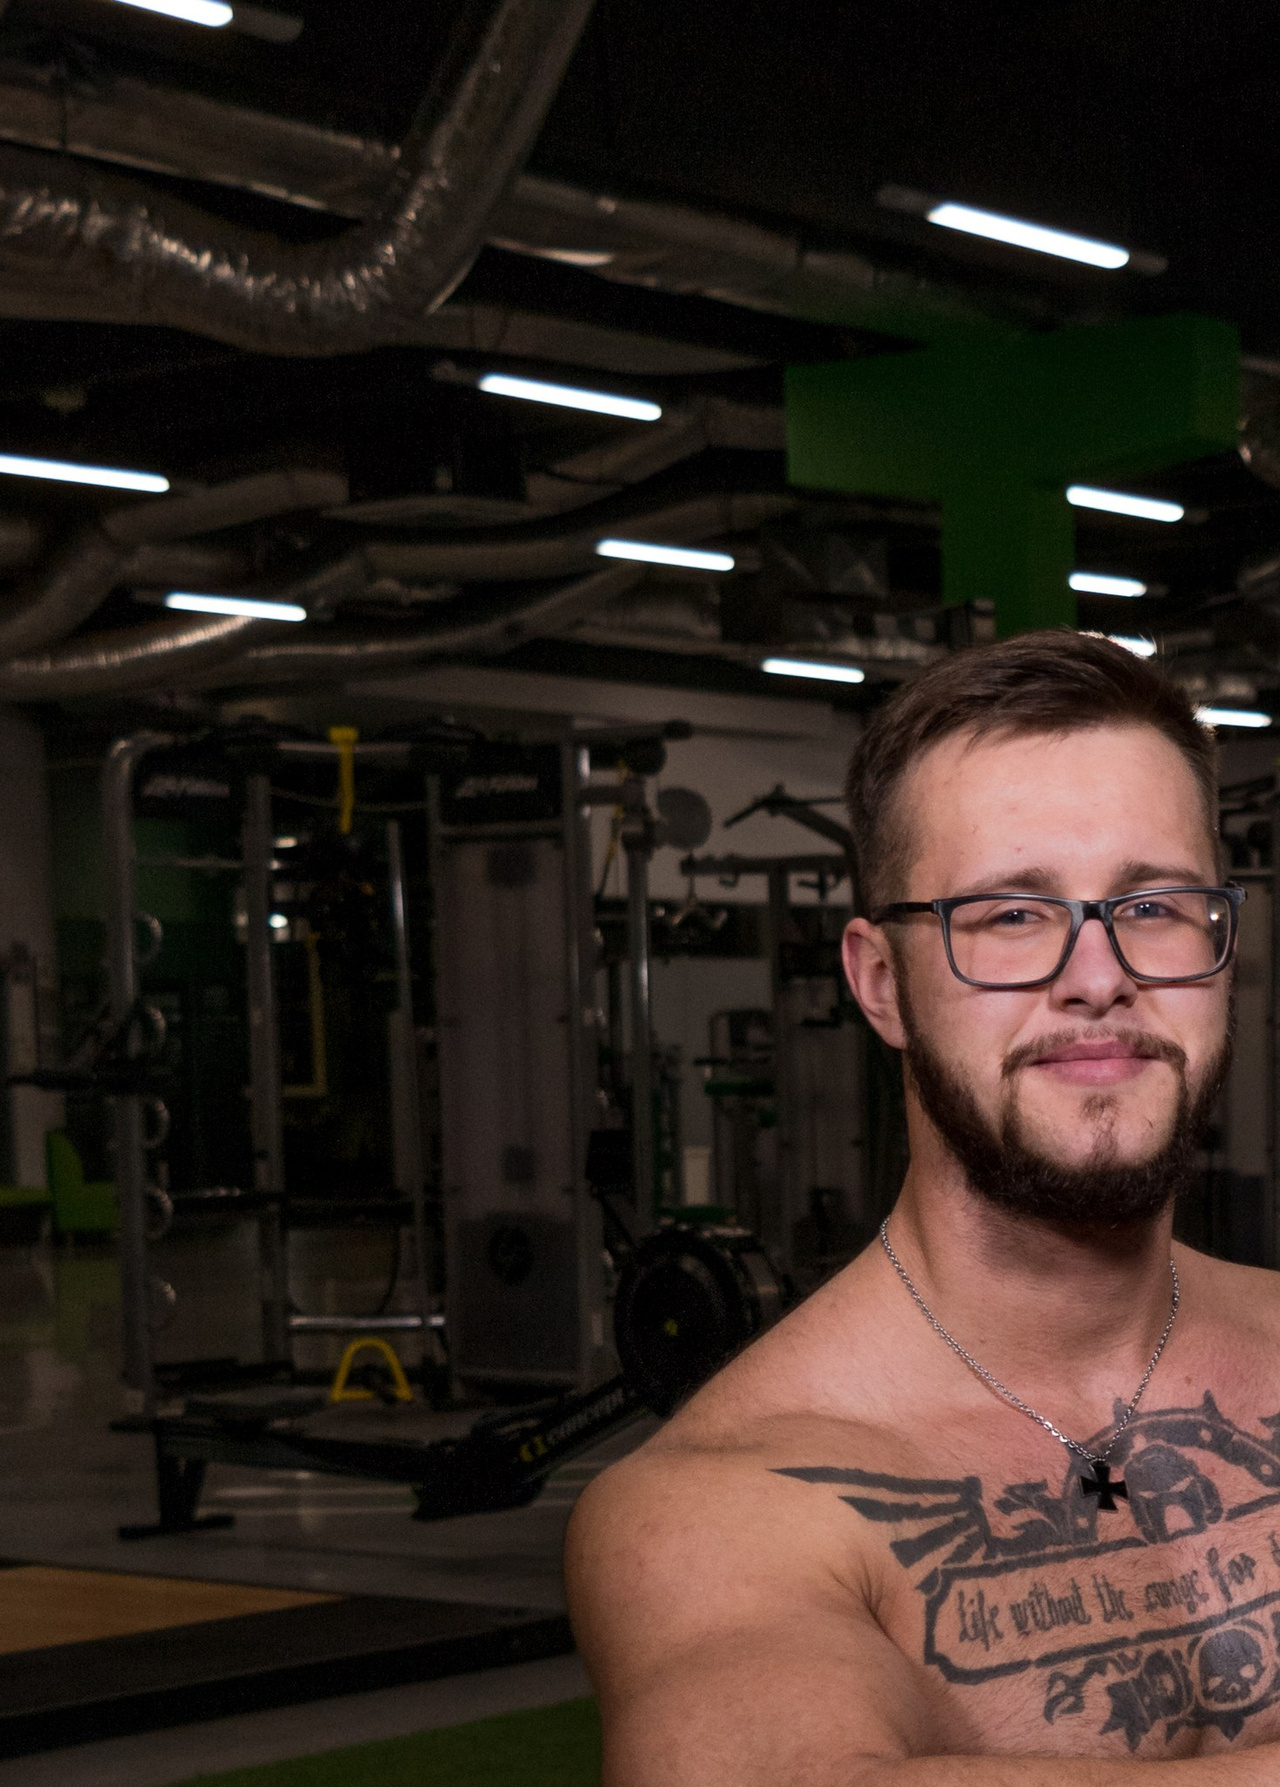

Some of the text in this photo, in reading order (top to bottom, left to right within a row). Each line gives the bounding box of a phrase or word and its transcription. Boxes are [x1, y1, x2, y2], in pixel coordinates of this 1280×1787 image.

[1009, 1580, 1092, 1637] without
[1091, 1572, 1135, 1624] the
[1206, 1546, 1257, 1603] for
